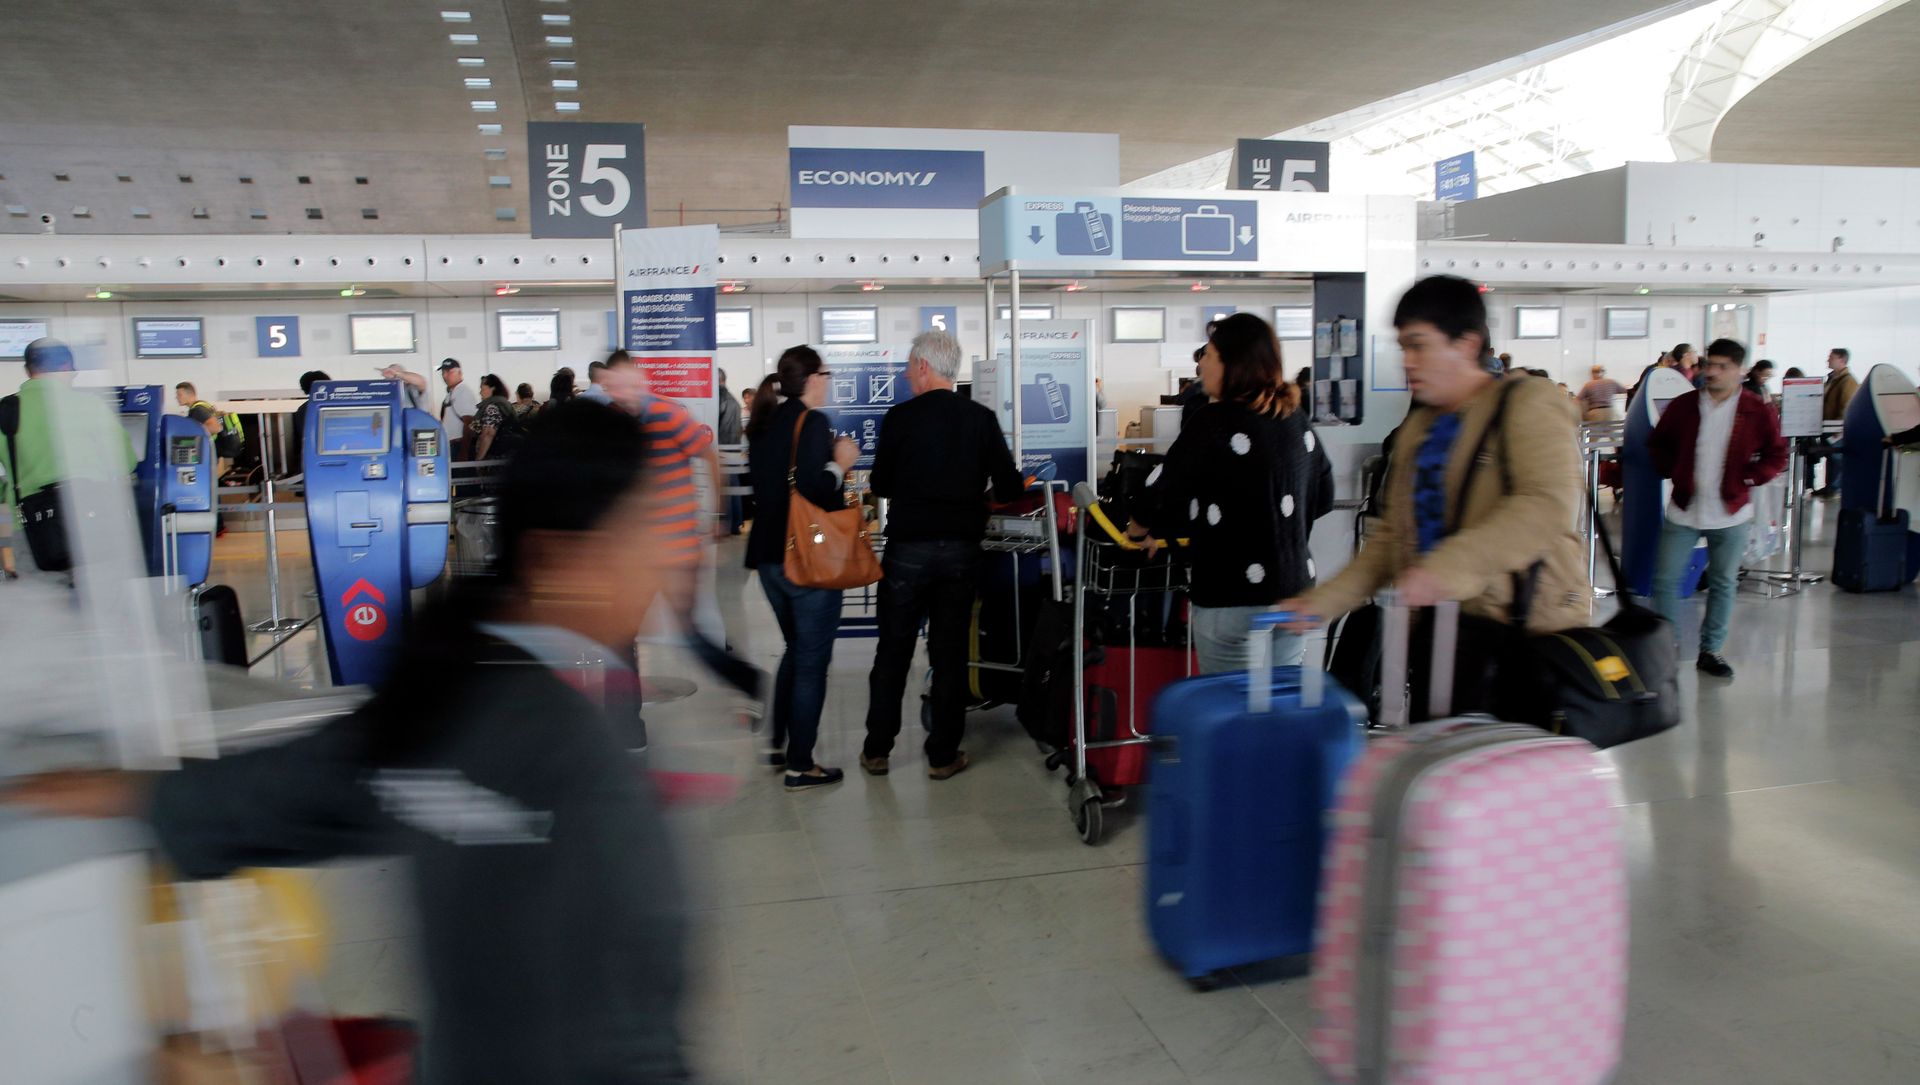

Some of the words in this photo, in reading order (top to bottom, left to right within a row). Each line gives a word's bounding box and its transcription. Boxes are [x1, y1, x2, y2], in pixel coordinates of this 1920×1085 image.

[799, 170, 921, 186] ECONOMY
[1252, 158, 1271, 190] NE
[546, 144, 571, 216] ZONE
[579, 144, 631, 218] 5
[1025, 202, 1063, 210] EXPRESS
[1123, 204, 1150, 213] Dépose
[1151, 203, 1182, 214] bagages
[1154, 213, 1171, 222] Drop
[628, 266, 690, 277] AIRFRANCE
[664, 293, 693, 302] CABINE
[270, 325, 287, 348] 5
[354, 606, 377, 625] e
